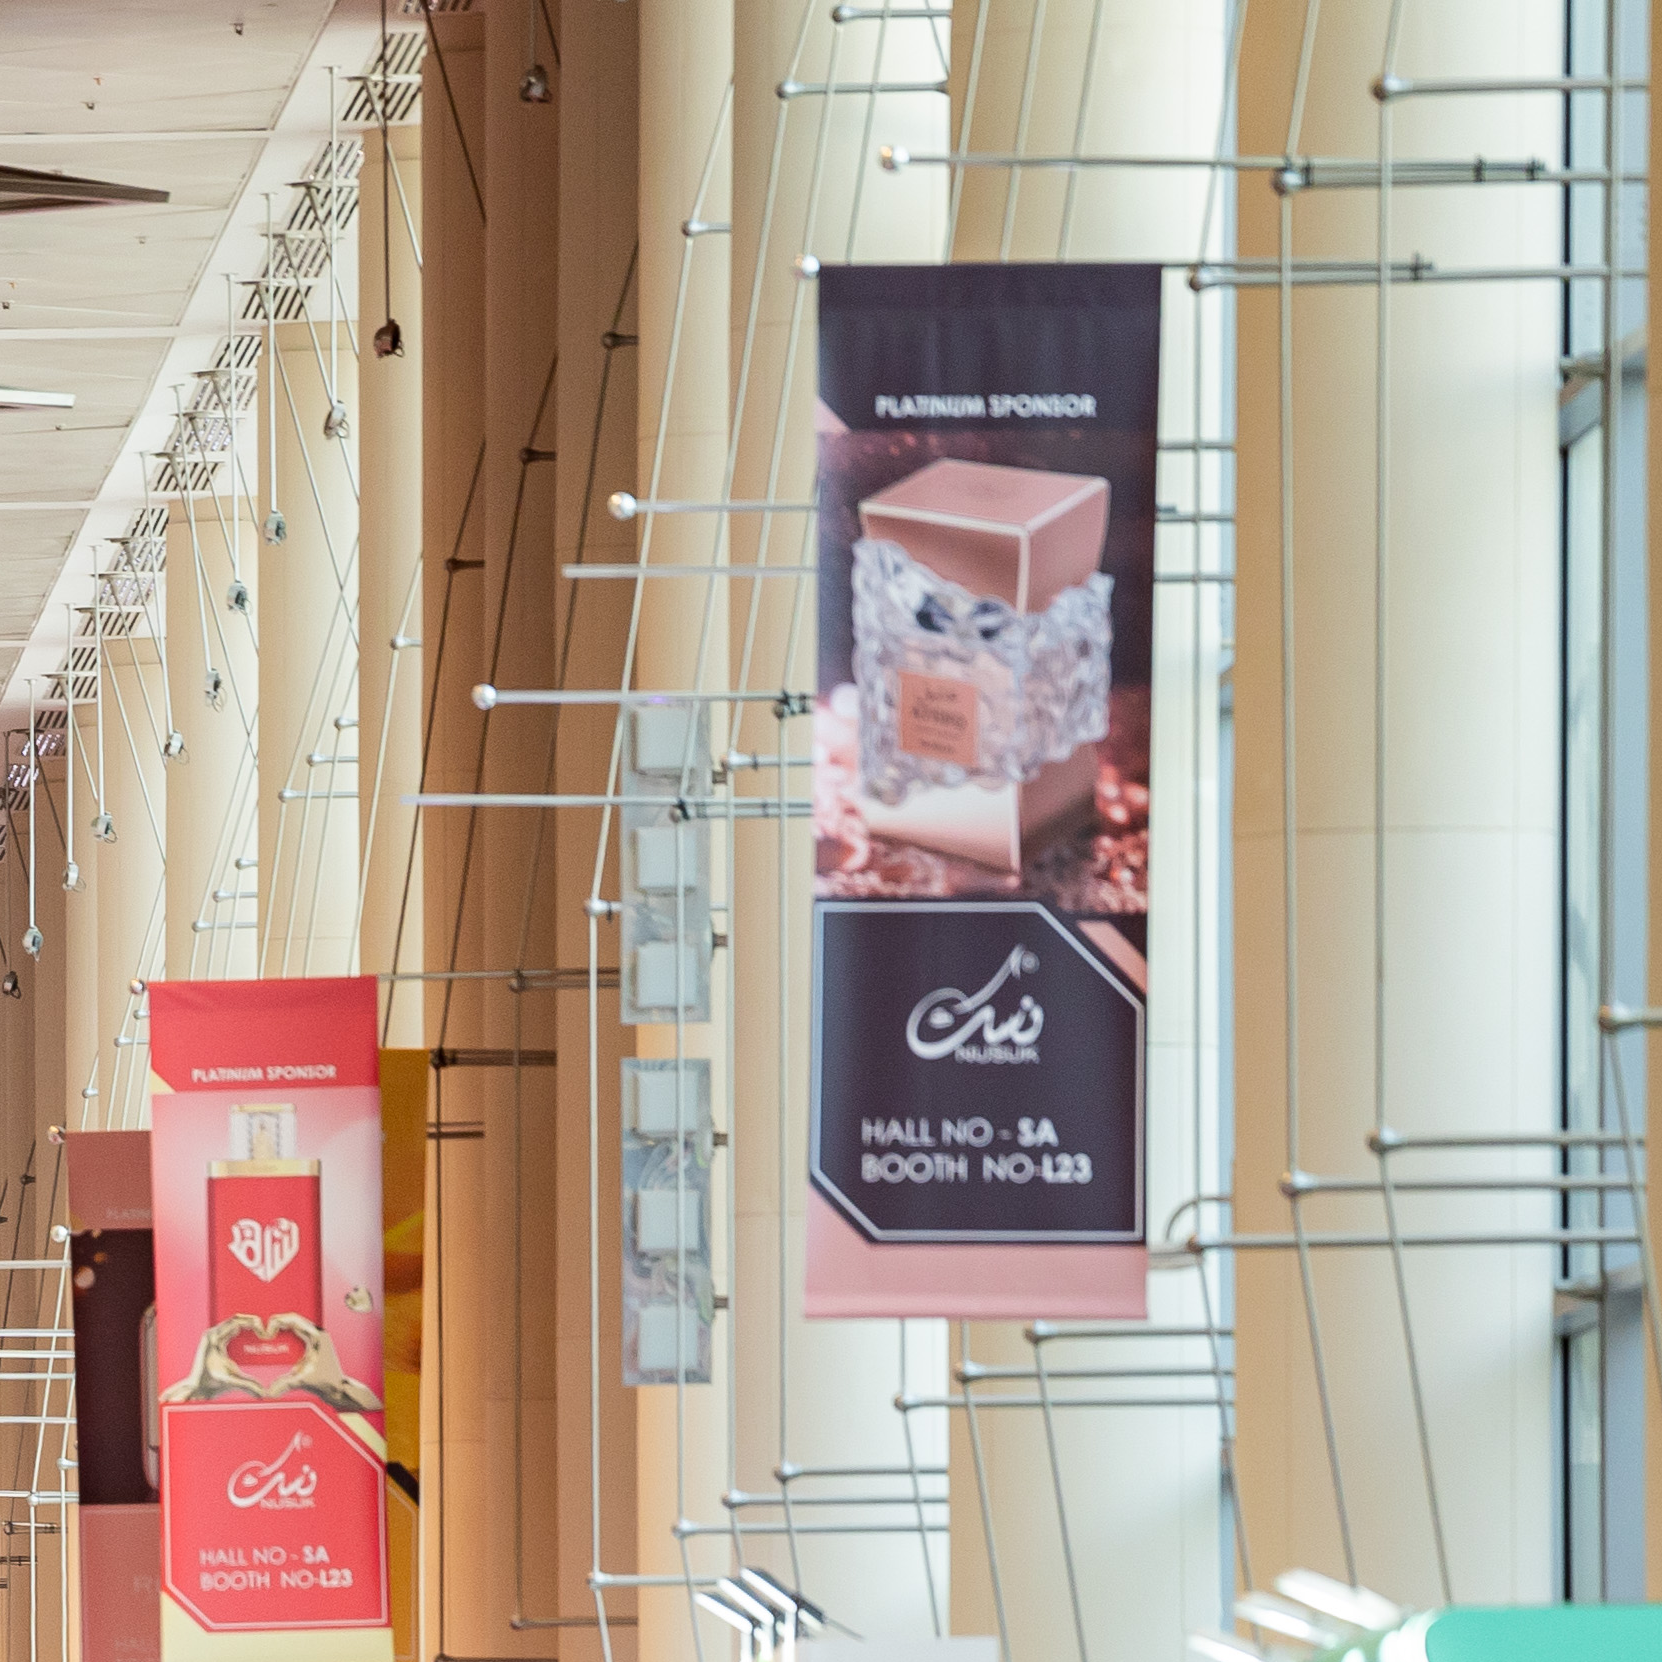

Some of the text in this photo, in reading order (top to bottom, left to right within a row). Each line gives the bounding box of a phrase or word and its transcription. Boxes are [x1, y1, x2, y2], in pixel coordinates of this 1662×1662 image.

[875, 393, 1097, 419] PLATINUM SPONSOR
[191, 1064, 337, 1083] PLATINUM SPONSOR
[861, 1116, 937, 1147] HALL
[941, 1116, 994, 1147] NO
[1017, 1116, 1059, 1147] SA
[861, 1152, 968, 1184] BOOTH
[199, 1545, 330, 1566] HALL NO SA
[199, 1569, 271, 1591] BOOTH
